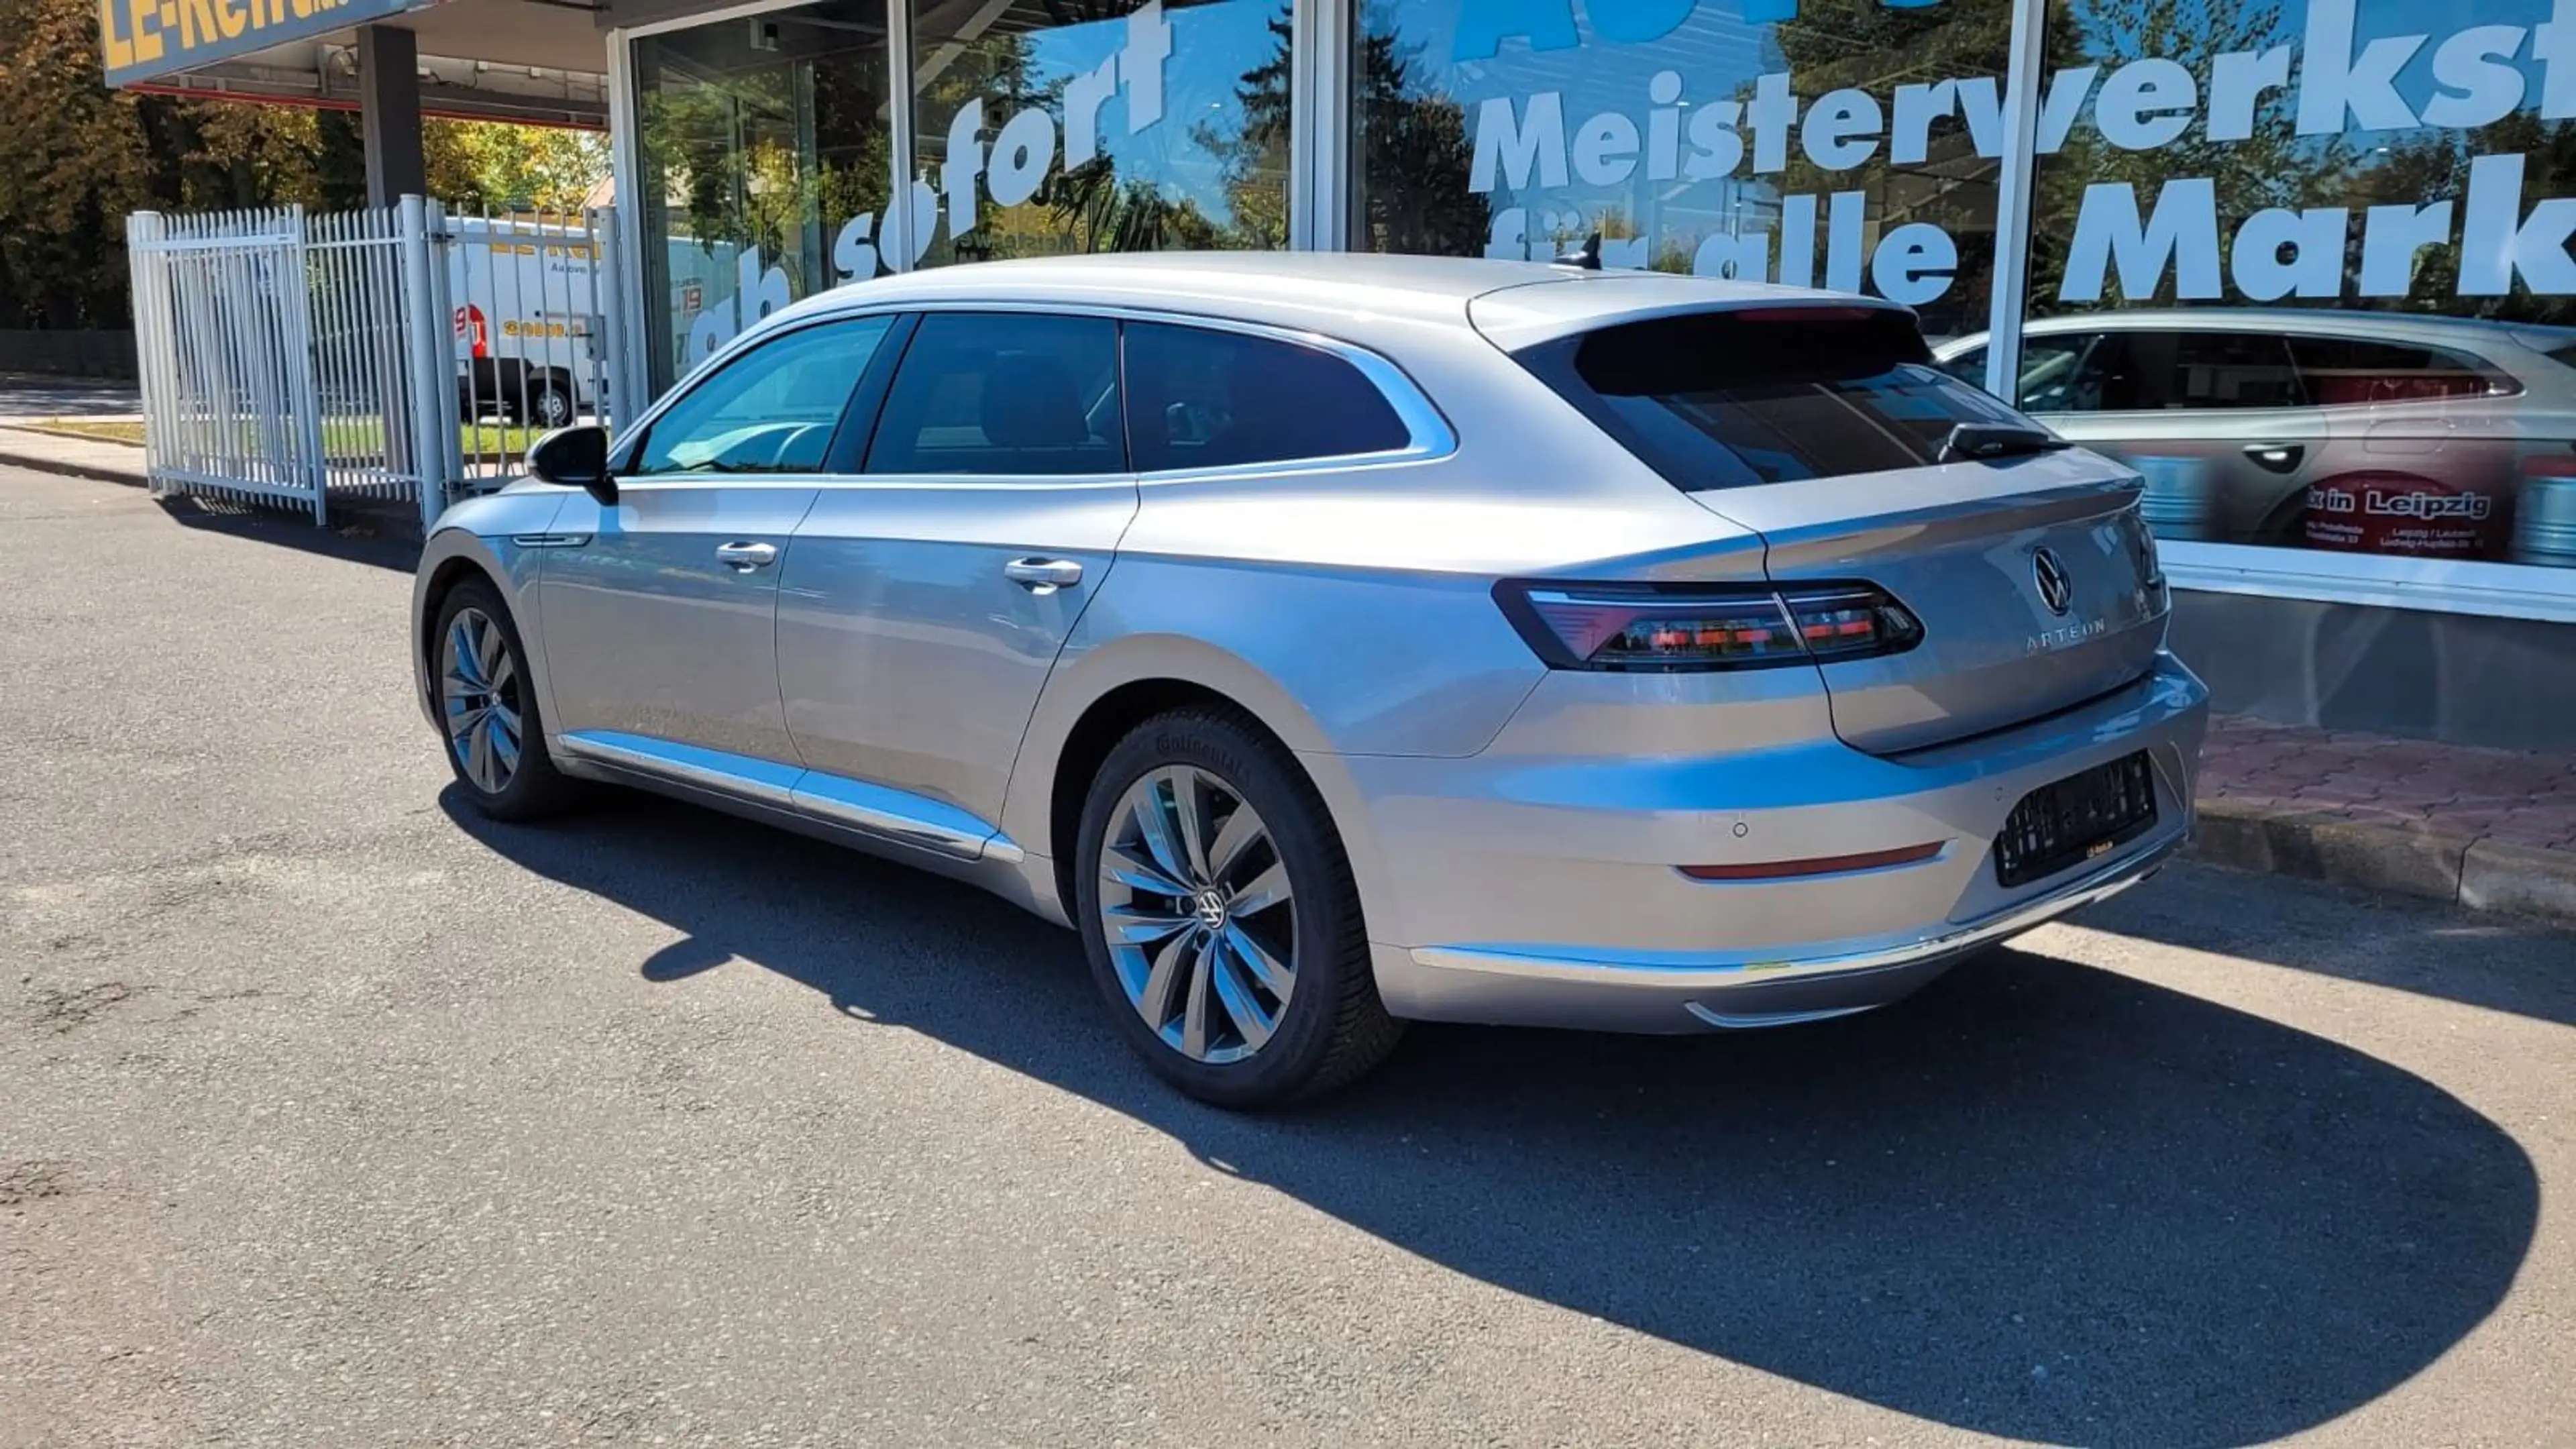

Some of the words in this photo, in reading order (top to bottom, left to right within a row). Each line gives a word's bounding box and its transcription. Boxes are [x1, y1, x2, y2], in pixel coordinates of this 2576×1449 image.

[833, 0, 1173, 286] sofort
[1693, 191, 1957, 305] alle
[2365, 490, 2491, 520] Leipzig
[2025, 617, 2105, 651] ARTEON
